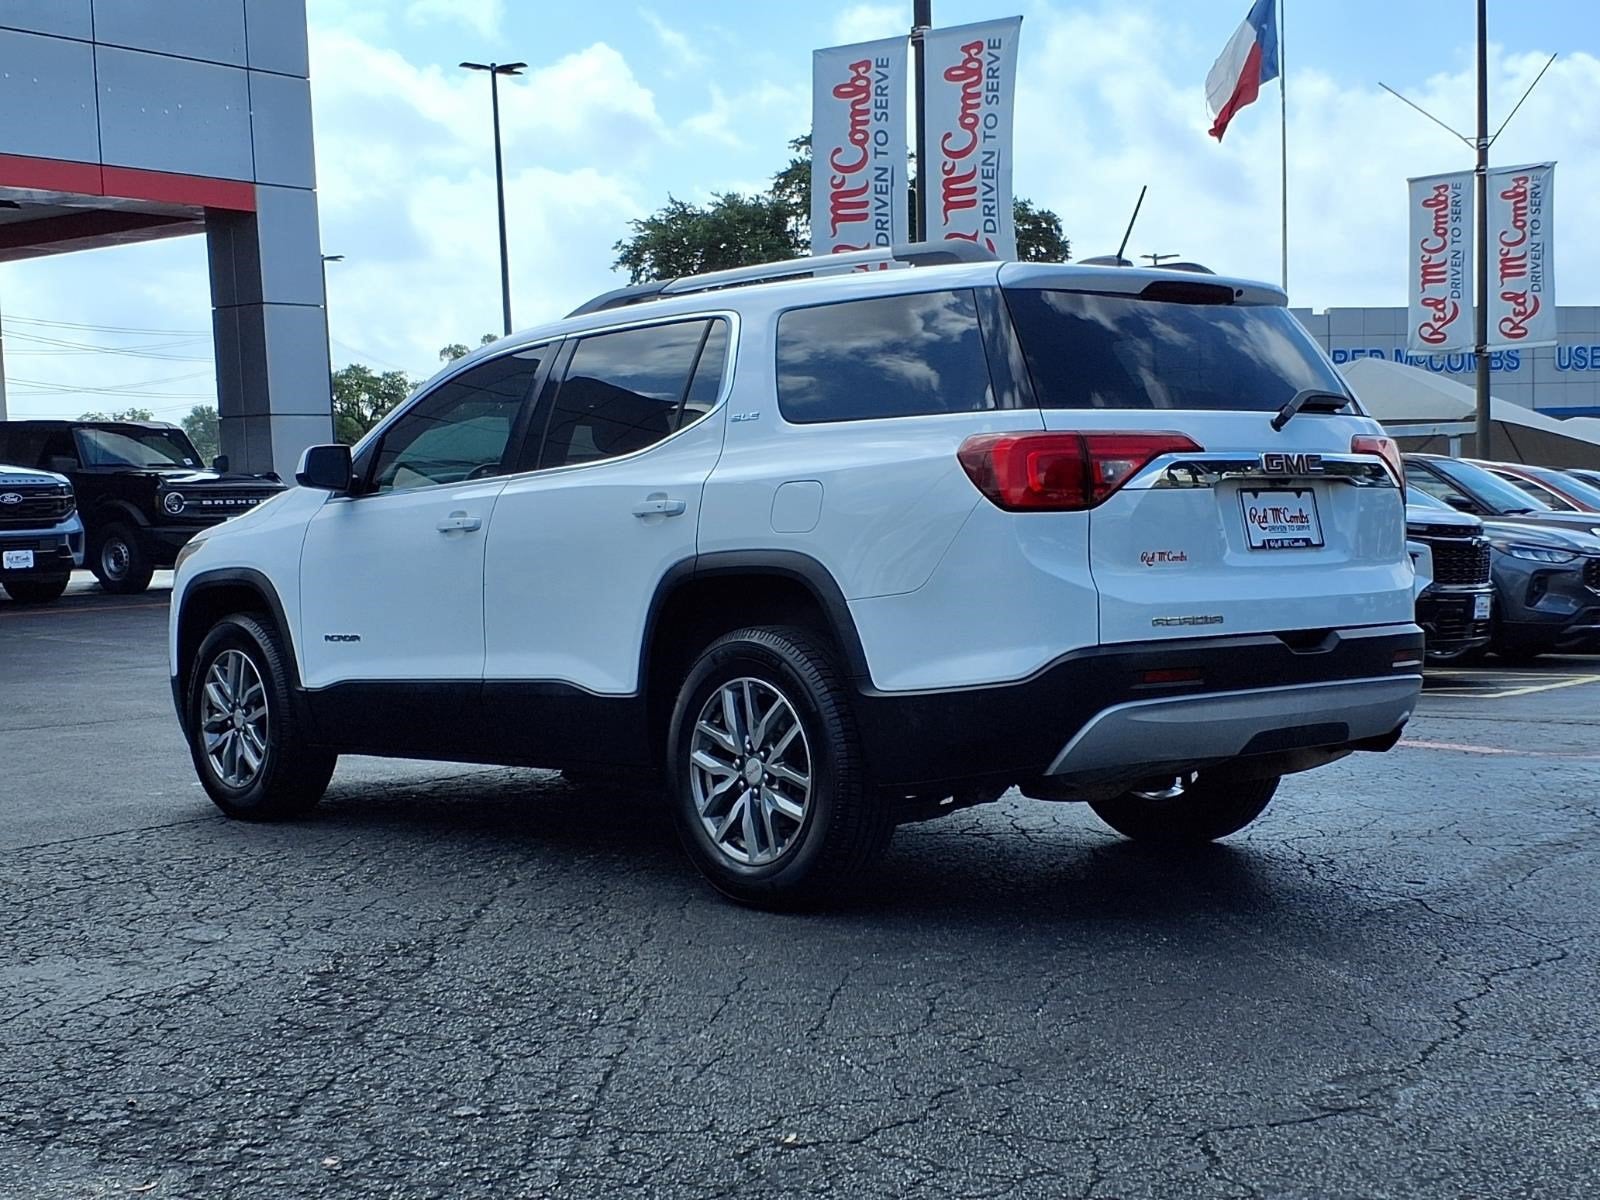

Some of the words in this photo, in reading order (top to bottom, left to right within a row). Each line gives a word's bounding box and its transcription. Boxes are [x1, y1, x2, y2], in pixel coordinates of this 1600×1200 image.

[874, 57, 890, 122] SERVE
[986, 37, 1002, 105] SERVE
[829, 59, 872, 238] McCombs
[874, 131, 889, 159] TO
[941, 40, 984, 226] McCombs
[983, 113, 998, 143] TO
[874, 166, 889, 247] DRIVEN
[982, 150, 997, 235] DRIVEN
[1451, 182, 1462, 223] SERVE
[1530, 175, 1542, 215] SERVE
[1420, 184, 1449, 293] McCombs
[1451, 227, 1462, 245] TO
[1499, 175, 1529, 288] McCombs
[1530, 219, 1542, 237] TO
[1451, 250, 1462, 299] DRIVEN
[1531, 242, 1542, 293] DRIVEN
[1418, 296, 1459, 344] Red
[1499, 290, 1540, 339] Red
[1557, 345, 1600, 370] USE
[1263, 453, 1324, 474] GMC
[1249, 507, 1268, 530] Red
[1152, 615, 1224, 627] ACADIA
